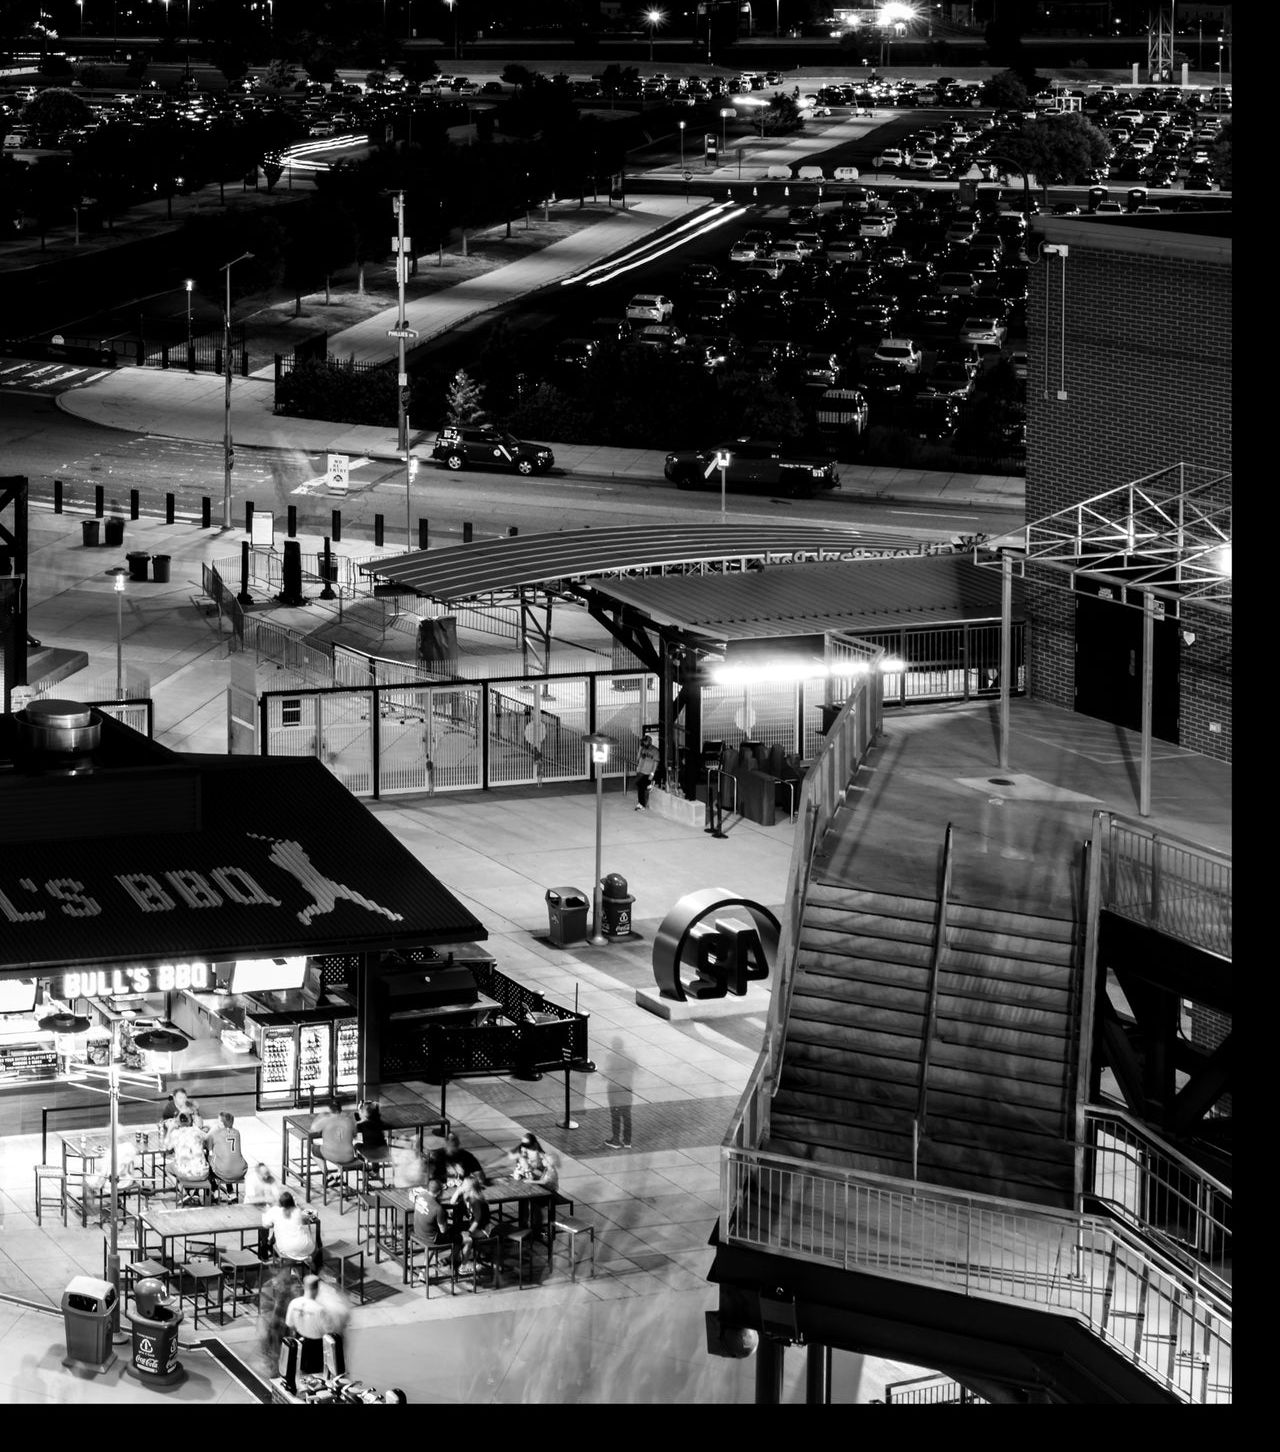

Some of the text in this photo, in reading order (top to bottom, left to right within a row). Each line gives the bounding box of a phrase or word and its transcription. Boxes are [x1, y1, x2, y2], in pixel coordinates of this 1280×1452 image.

[113, 866, 282, 913] BBQ
[63, 962, 208, 998] BULL'S BBQ
[226, 1137, 236, 1152] 7
